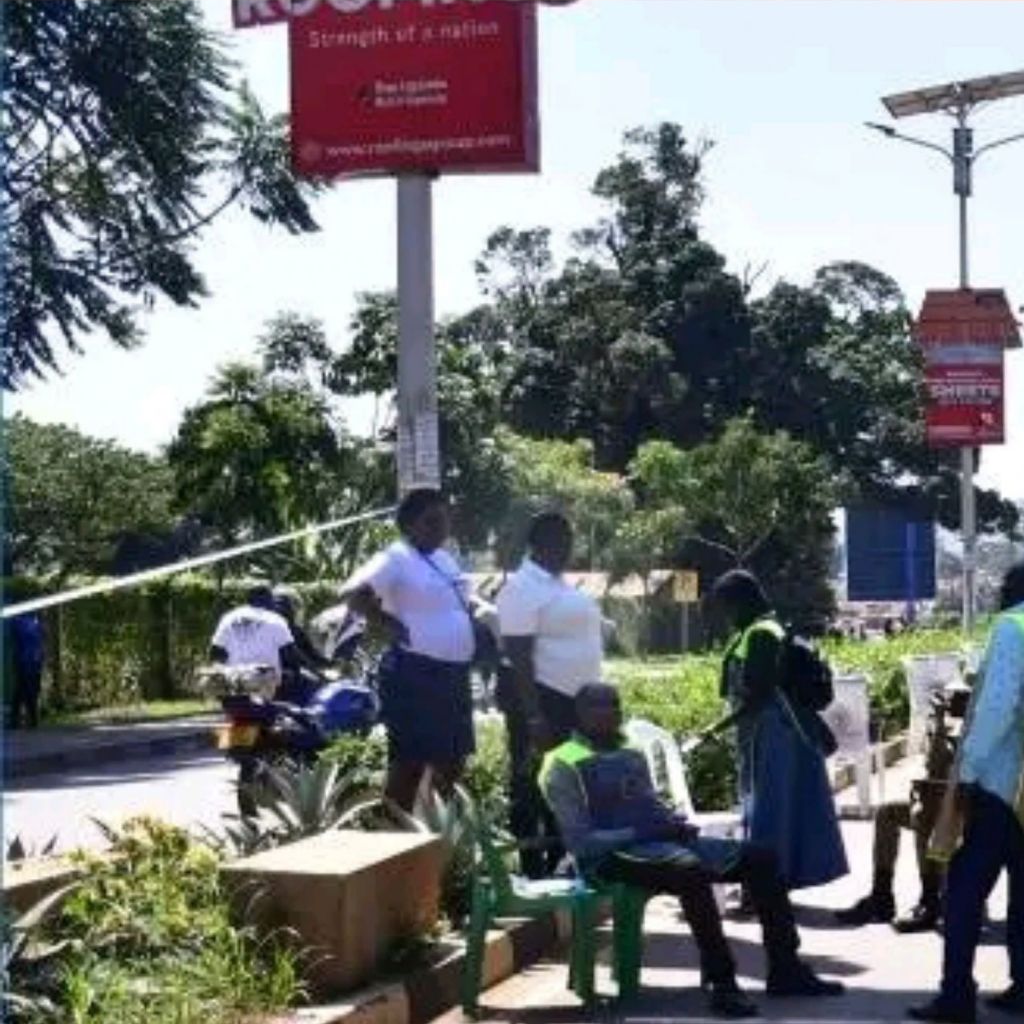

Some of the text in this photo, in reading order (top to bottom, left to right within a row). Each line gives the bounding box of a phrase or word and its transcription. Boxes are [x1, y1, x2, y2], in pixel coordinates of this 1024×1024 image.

[308, 28, 388, 49] Strength
[396, 26, 415, 42] of
[440, 21, 499, 38] nation
